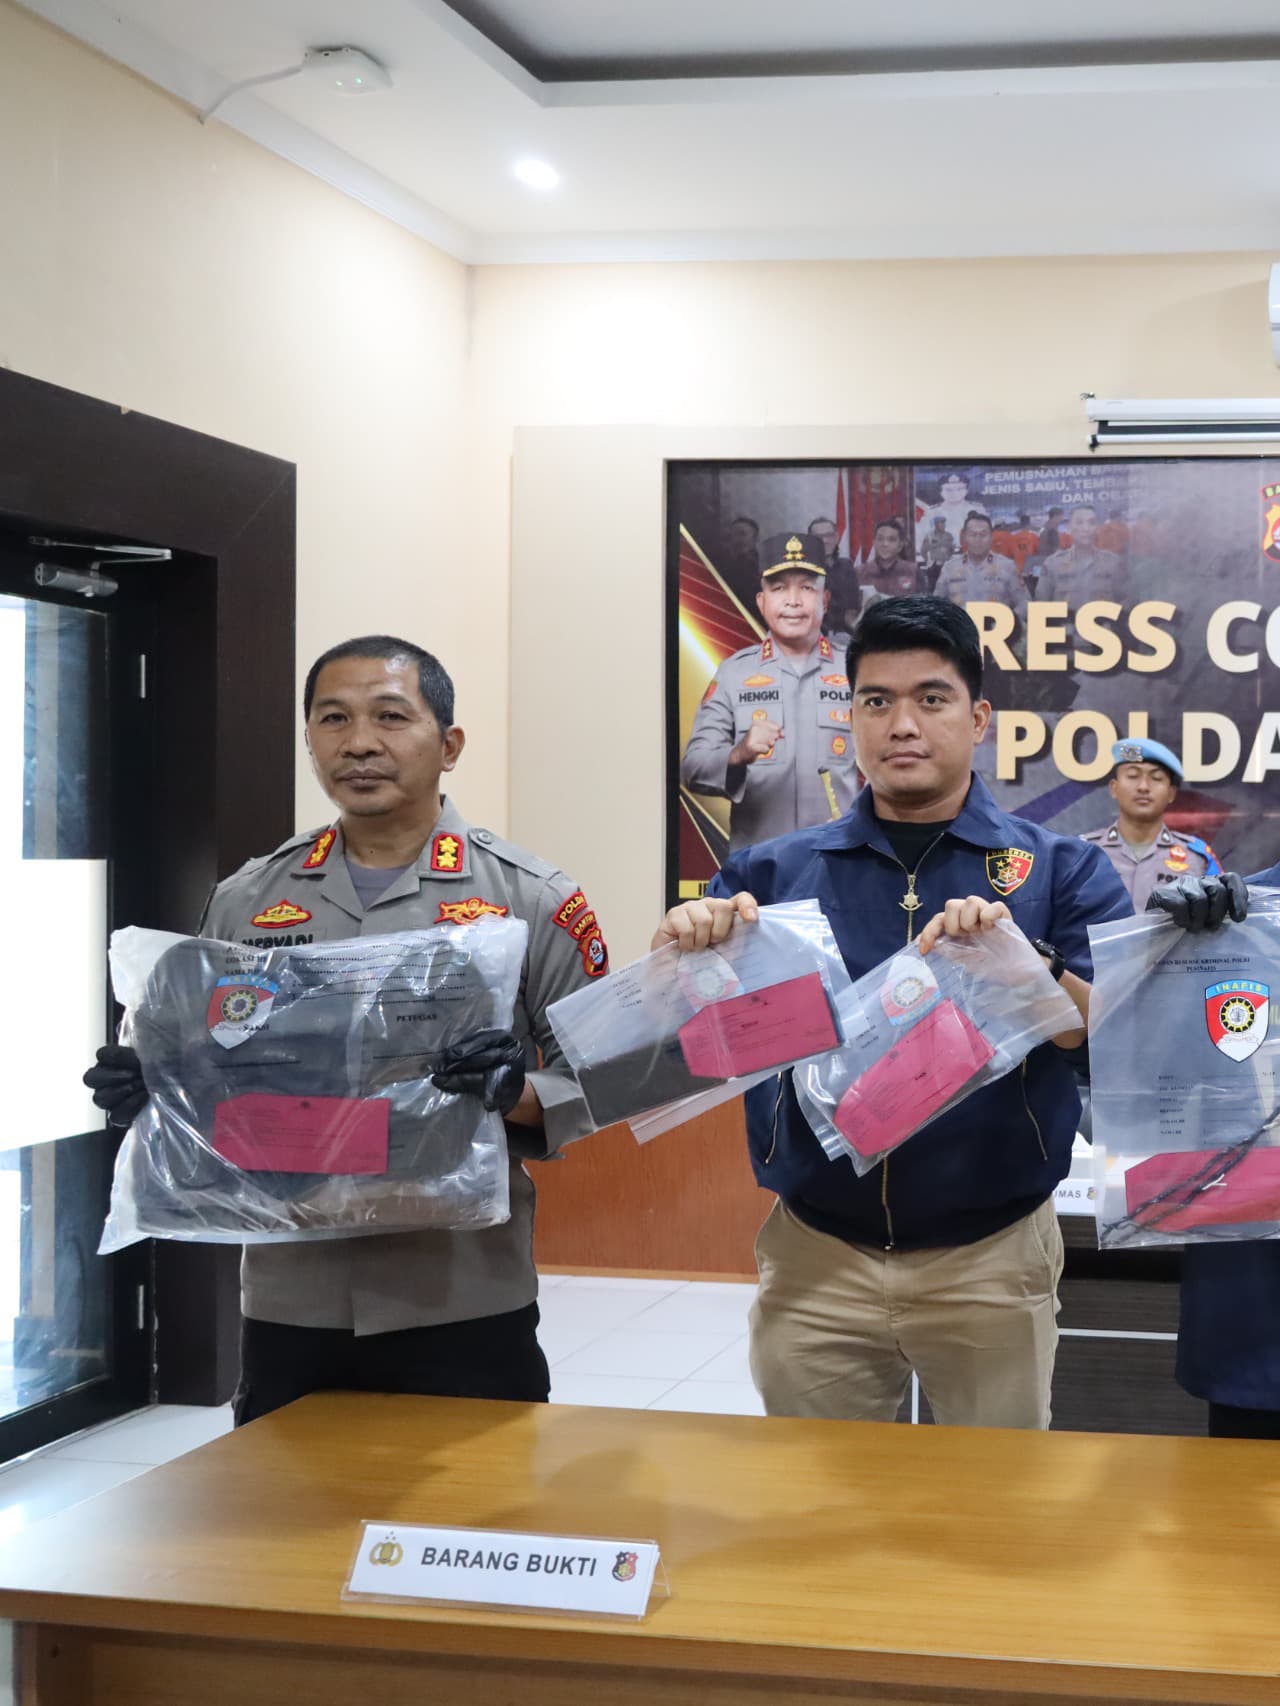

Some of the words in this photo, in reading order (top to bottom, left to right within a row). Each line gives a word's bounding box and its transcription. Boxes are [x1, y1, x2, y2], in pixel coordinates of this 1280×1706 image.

[984, 466, 1086, 482] PEMUSNAHAN
[982, 482, 1020, 496] JENIS
[1062, 493, 1093, 503] DAN
[965, 600, 1177, 673] RESS
[739, 690, 779, 702] HENGKI
[1216, 982, 1262, 992] INAFIS
[420, 1547, 518, 1572] BARANG
[526, 1555, 596, 1576] BUKTI
